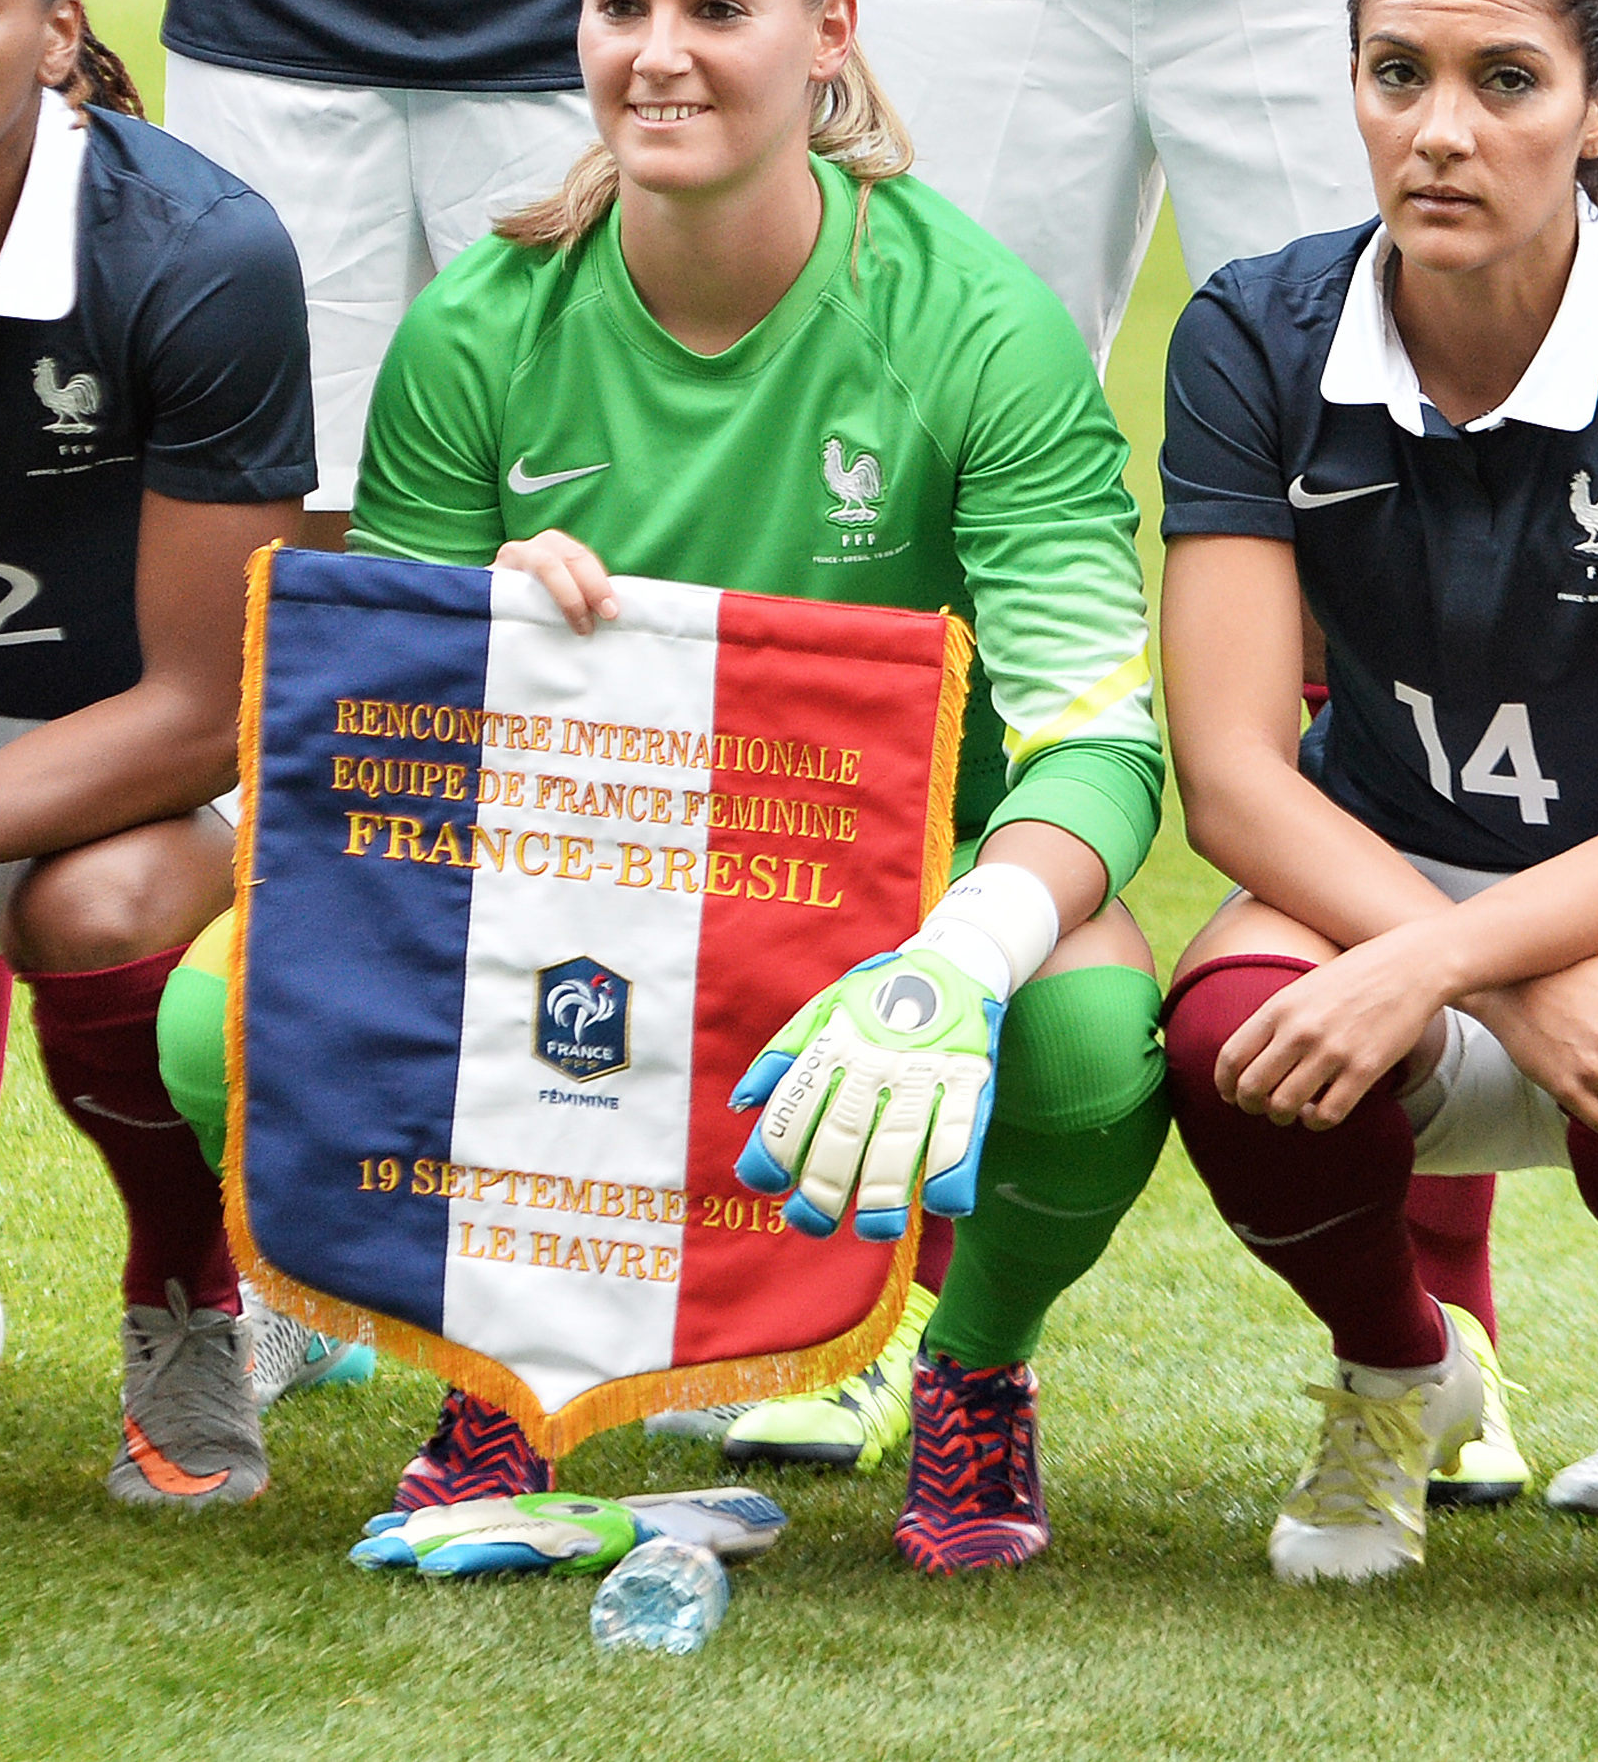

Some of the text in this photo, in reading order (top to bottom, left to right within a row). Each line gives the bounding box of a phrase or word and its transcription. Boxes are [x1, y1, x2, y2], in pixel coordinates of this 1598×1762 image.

[333, 698, 863, 786] RENCONTRE INTERNATIONALE
[1393, 679, 1561, 826] 14
[330, 755, 860, 843] EQUIPE DE FRANCE FEMININE
[341, 810, 844, 909] FRANCE-BRESIL
[546, 1040, 615, 1061] FRANCE
[768, 1036, 831, 1140] uhlsport
[357, 1157, 789, 1235] 19 SEPTEMBRE 2015
[457, 1221, 682, 1284] LE HAVRE
